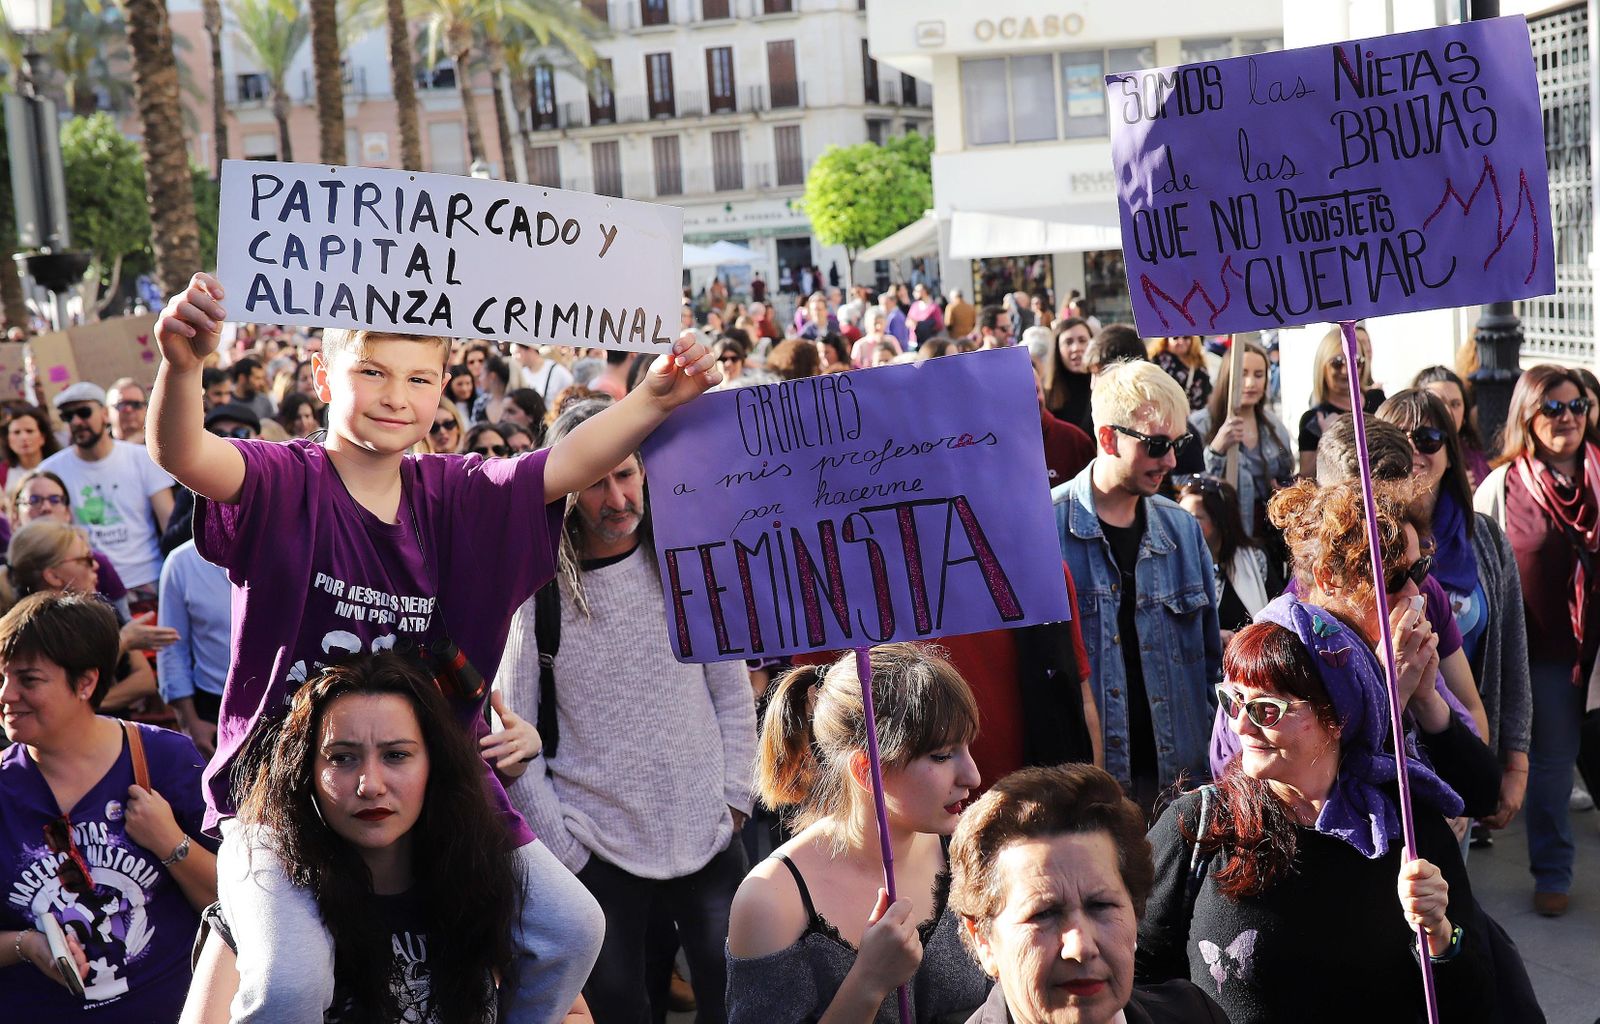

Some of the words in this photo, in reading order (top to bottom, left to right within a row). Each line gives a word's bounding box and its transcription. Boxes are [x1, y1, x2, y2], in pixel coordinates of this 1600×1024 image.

[974, 13, 1085, 41] OCASO
[1121, 65, 1224, 125] SOMOS
[1249, 56, 1316, 105] las
[1332, 41, 1481, 102] NIETAS
[1152, 145, 1200, 195] de
[1237, 127, 1304, 184] las
[1328, 85, 1498, 180] BRUJAS
[250, 173, 581, 248] PATRIARCADO
[598, 223, 618, 258] Y
[1132, 201, 1198, 265] QUE
[1209, 193, 1262, 253] NO
[1275, 188, 1396, 244] PUDISTEIS
[248, 230, 462, 285] CAPITAL
[1245, 229, 1457, 325] QUEMAR
[245, 273, 452, 329] ALIANZA
[472, 296, 671, 345] CRIMINAL
[735, 375, 861, 457] GRACIAS
[673, 483, 696, 496] a
[715, 460, 792, 488] mis
[810, 432, 998, 482] profesoras
[729, 503, 785, 539] por
[812, 478, 924, 508] hacerme
[313, 572, 345, 598] POR
[400, 596, 436, 614] DERE
[397, 614, 432, 633] ATR
[73, 821, 109, 847] NTAS
[86, 844, 160, 889] HISTORIA
